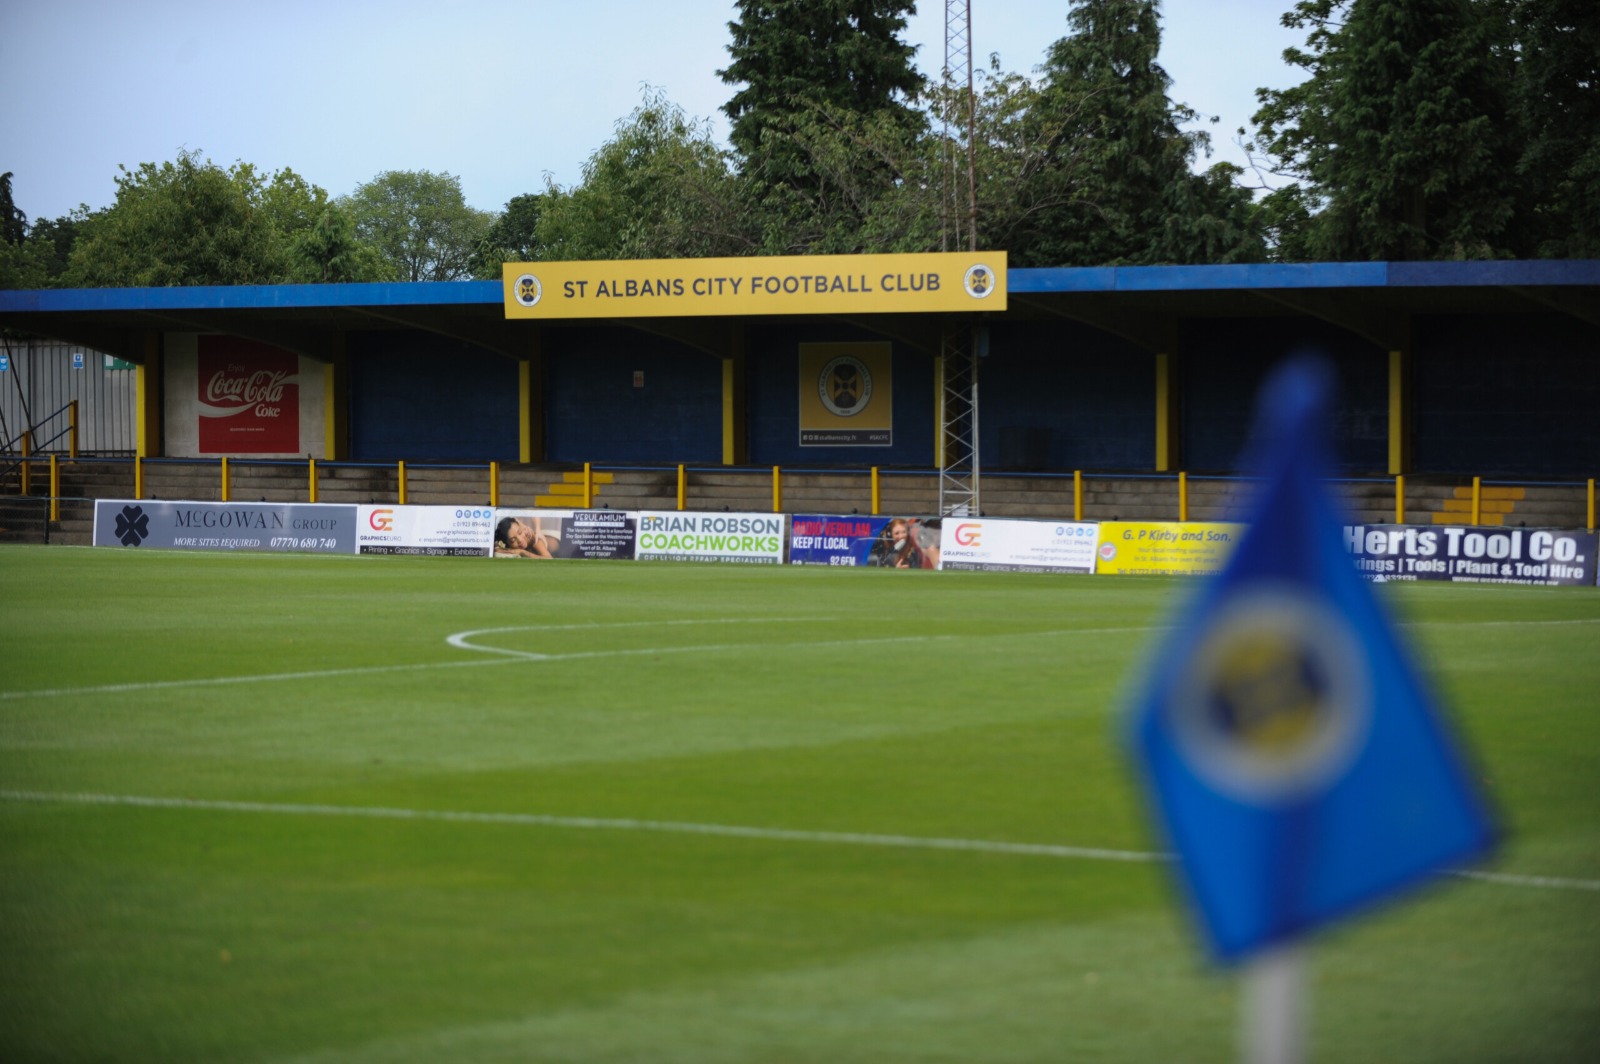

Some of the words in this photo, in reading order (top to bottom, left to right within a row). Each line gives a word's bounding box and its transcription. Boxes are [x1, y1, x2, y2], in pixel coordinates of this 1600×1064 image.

[563, 280, 588, 298] ST
[596, 278, 686, 298] ALBANS
[692, 277, 742, 296] CITY
[751, 274, 872, 294] FOOTBALL
[880, 273, 940, 292] CLUB
[228, 364, 245, 373] Enjoy
[255, 404, 280, 417] Coke
[292, 519, 337, 530] GROUP
[640, 517, 696, 532] BRIAN
[701, 518, 780, 534] ROBSON
[793, 521, 823, 536] RADIO
[824, 522, 871, 537] VERULAM
[640, 533, 779, 552] COACHWORKS
[1123, 530, 1134, 540] G.
[1138, 530, 1146, 540] P
[1148, 530, 1178, 542] Kirby
[1181, 531, 1203, 541] and
[1207, 531, 1231, 542] Son.
[173, 537, 197, 546] MORE
[198, 538, 220, 547] SITES
[270, 537, 298, 548] 07770
[300, 537, 318, 548] 680
[319, 538, 336, 549] 740
[793, 537, 813, 549] KEEP
[815, 537, 822, 549] IT
[823, 537, 849, 550] LOCAL
[1343, 526, 1437, 556] Herts
[1444, 528, 1522, 559] Tool
[1529, 531, 1585, 562] Co.
[395, 547, 420, 555] Graphics
[426, 547, 448, 555] Signage
[830, 556, 856, 566] 926FM
[1406, 558, 1447, 572] Tools
[1456, 560, 1498, 575] Plant
[1501, 562, 1510, 576] &
[1513, 562, 1547, 577] Tool
[1551, 564, 1584, 579] Hire
